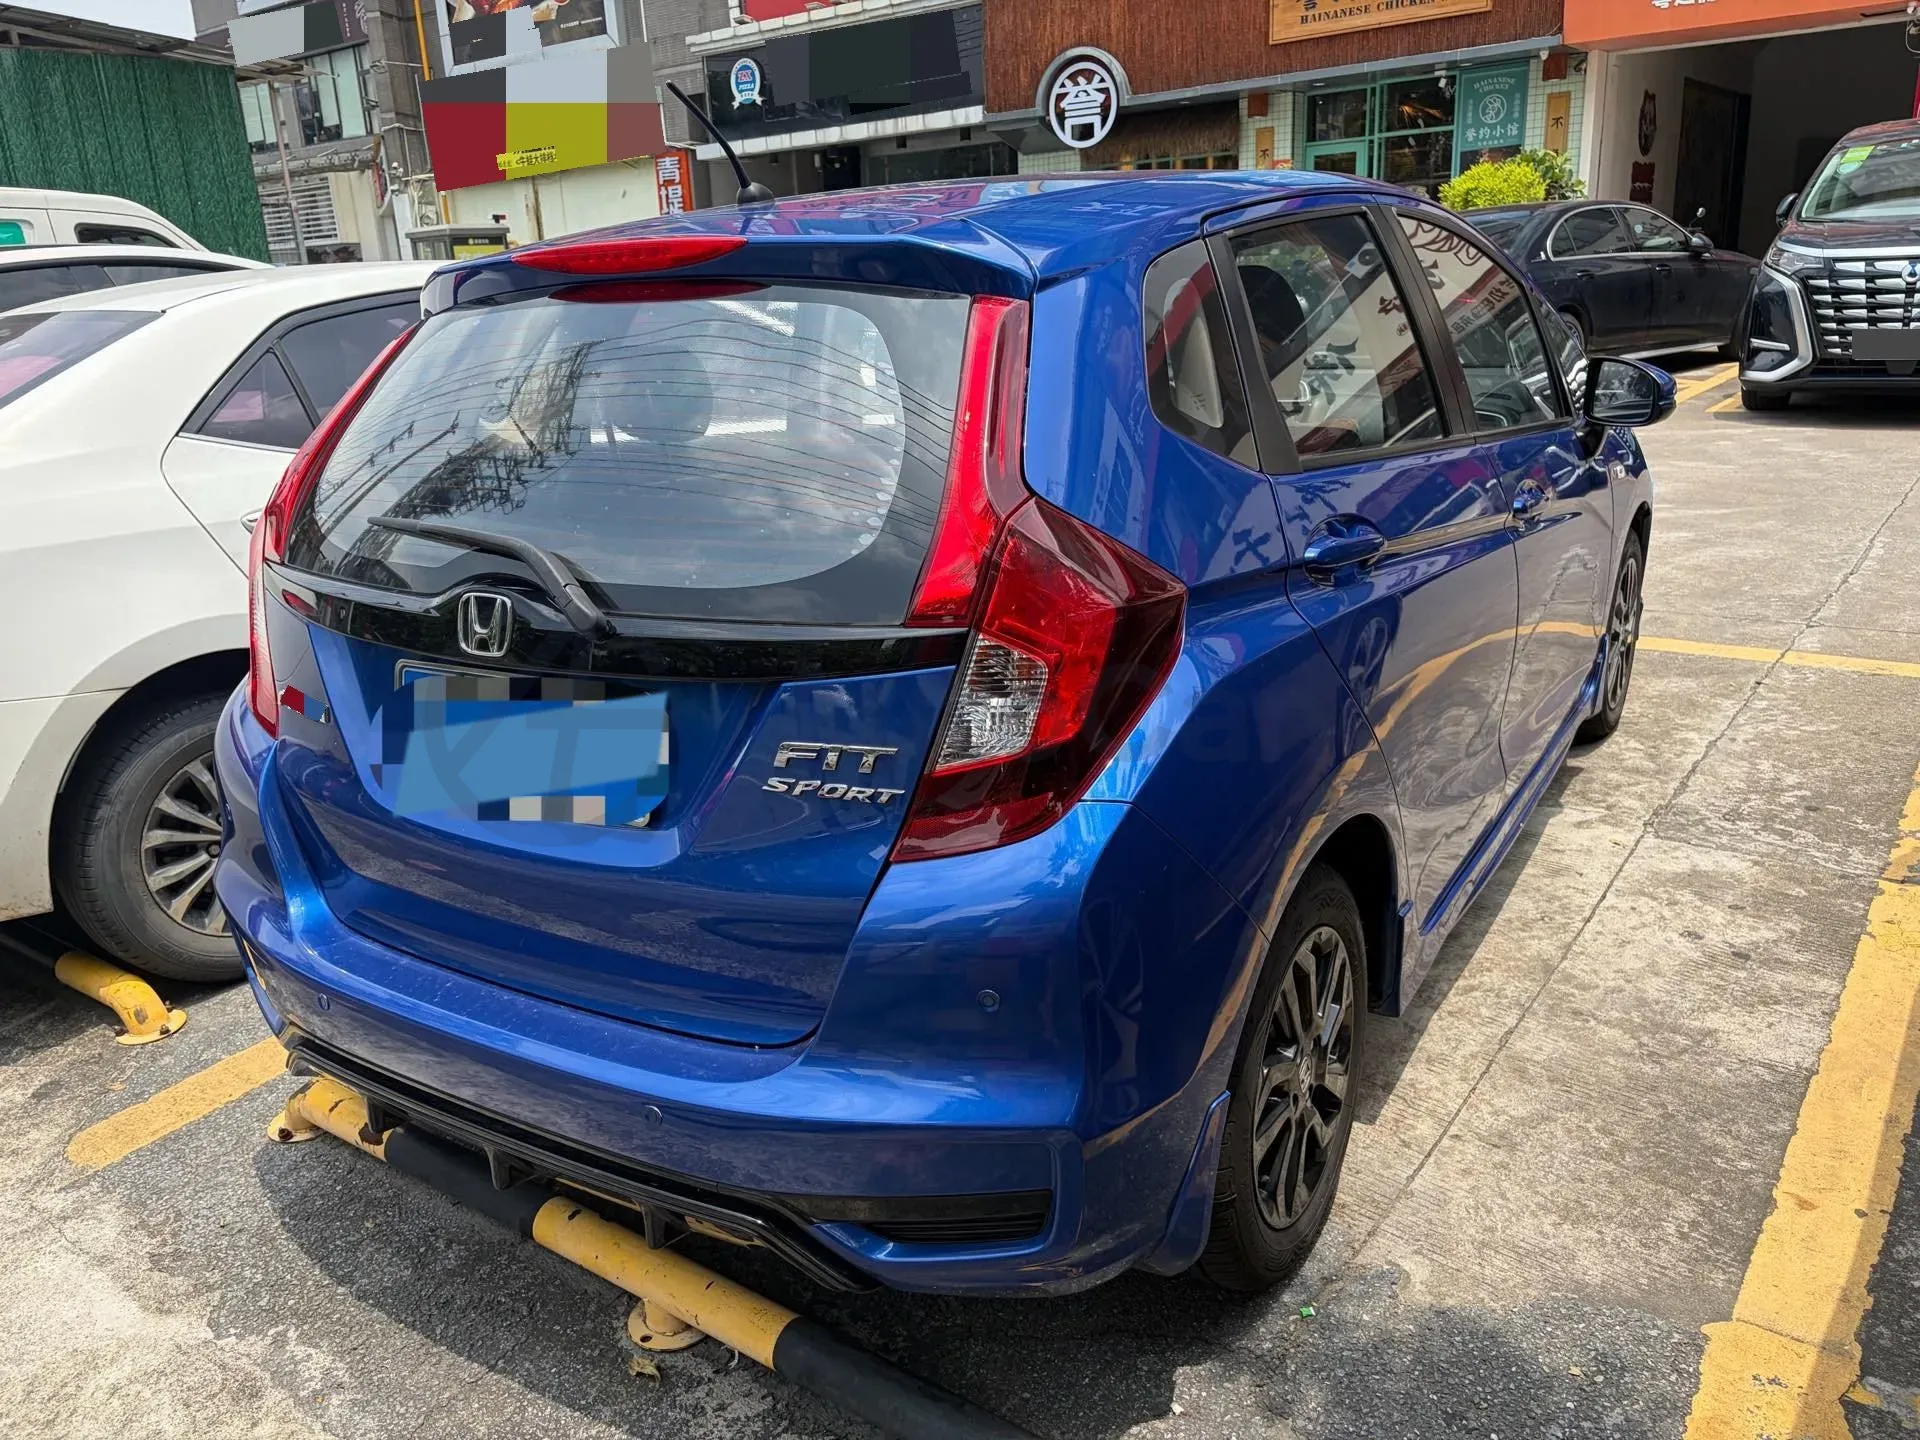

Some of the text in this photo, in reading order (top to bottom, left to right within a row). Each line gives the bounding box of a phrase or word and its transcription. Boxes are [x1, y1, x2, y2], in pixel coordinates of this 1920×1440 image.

[1300, 4, 1371, 24] HAINANESE
[773, 741, 898, 774] FIT
[762, 776, 905, 804] SPORT
